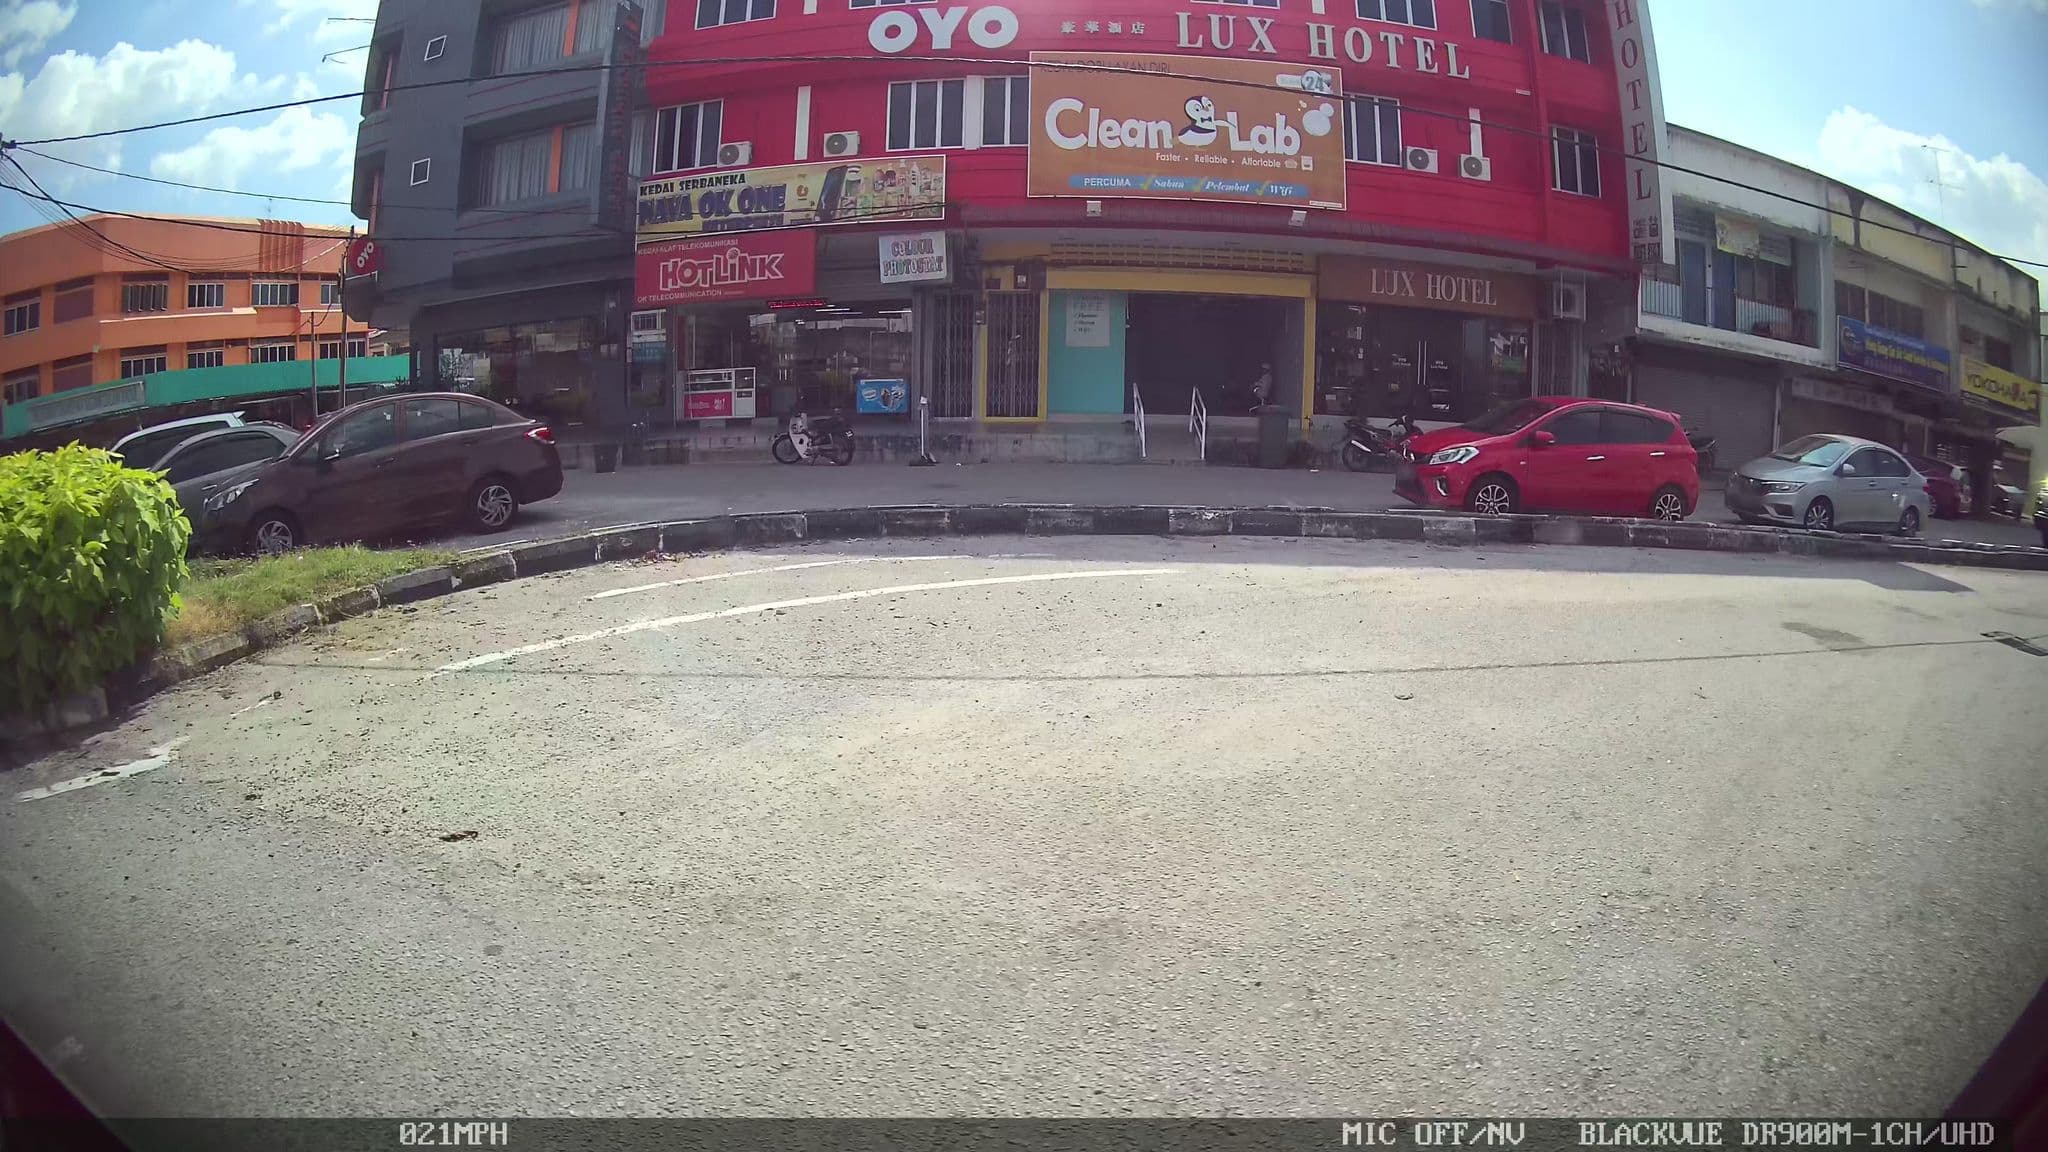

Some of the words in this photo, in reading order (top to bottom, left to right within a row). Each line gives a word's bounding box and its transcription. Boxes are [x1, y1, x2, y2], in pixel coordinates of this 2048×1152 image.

[868, 6, 1019, 53] OYO
[1176, 12, 1278, 54] LUX
[1306, 22, 1470, 80] HOTEL
[1614, 0, 1652, 200] HOTEL
[1045, 98, 1174, 150] Clean
[1226, 111, 1300, 155] Lab
[1156, 152, 1181, 162] Faster
[1194, 154, 1228, 165] Reliable
[640, 182, 674, 196] KEDAI
[679, 173, 746, 191] SERBANEKA
[1084, 177, 1131, 187] PERCUMA
[357, 242, 374, 267] OYO
[649, 289, 722, 301] TELECOMMUNICATION
[1371, 268, 1415, 297] LUX
[1426, 273, 1497, 306] HOTEL
